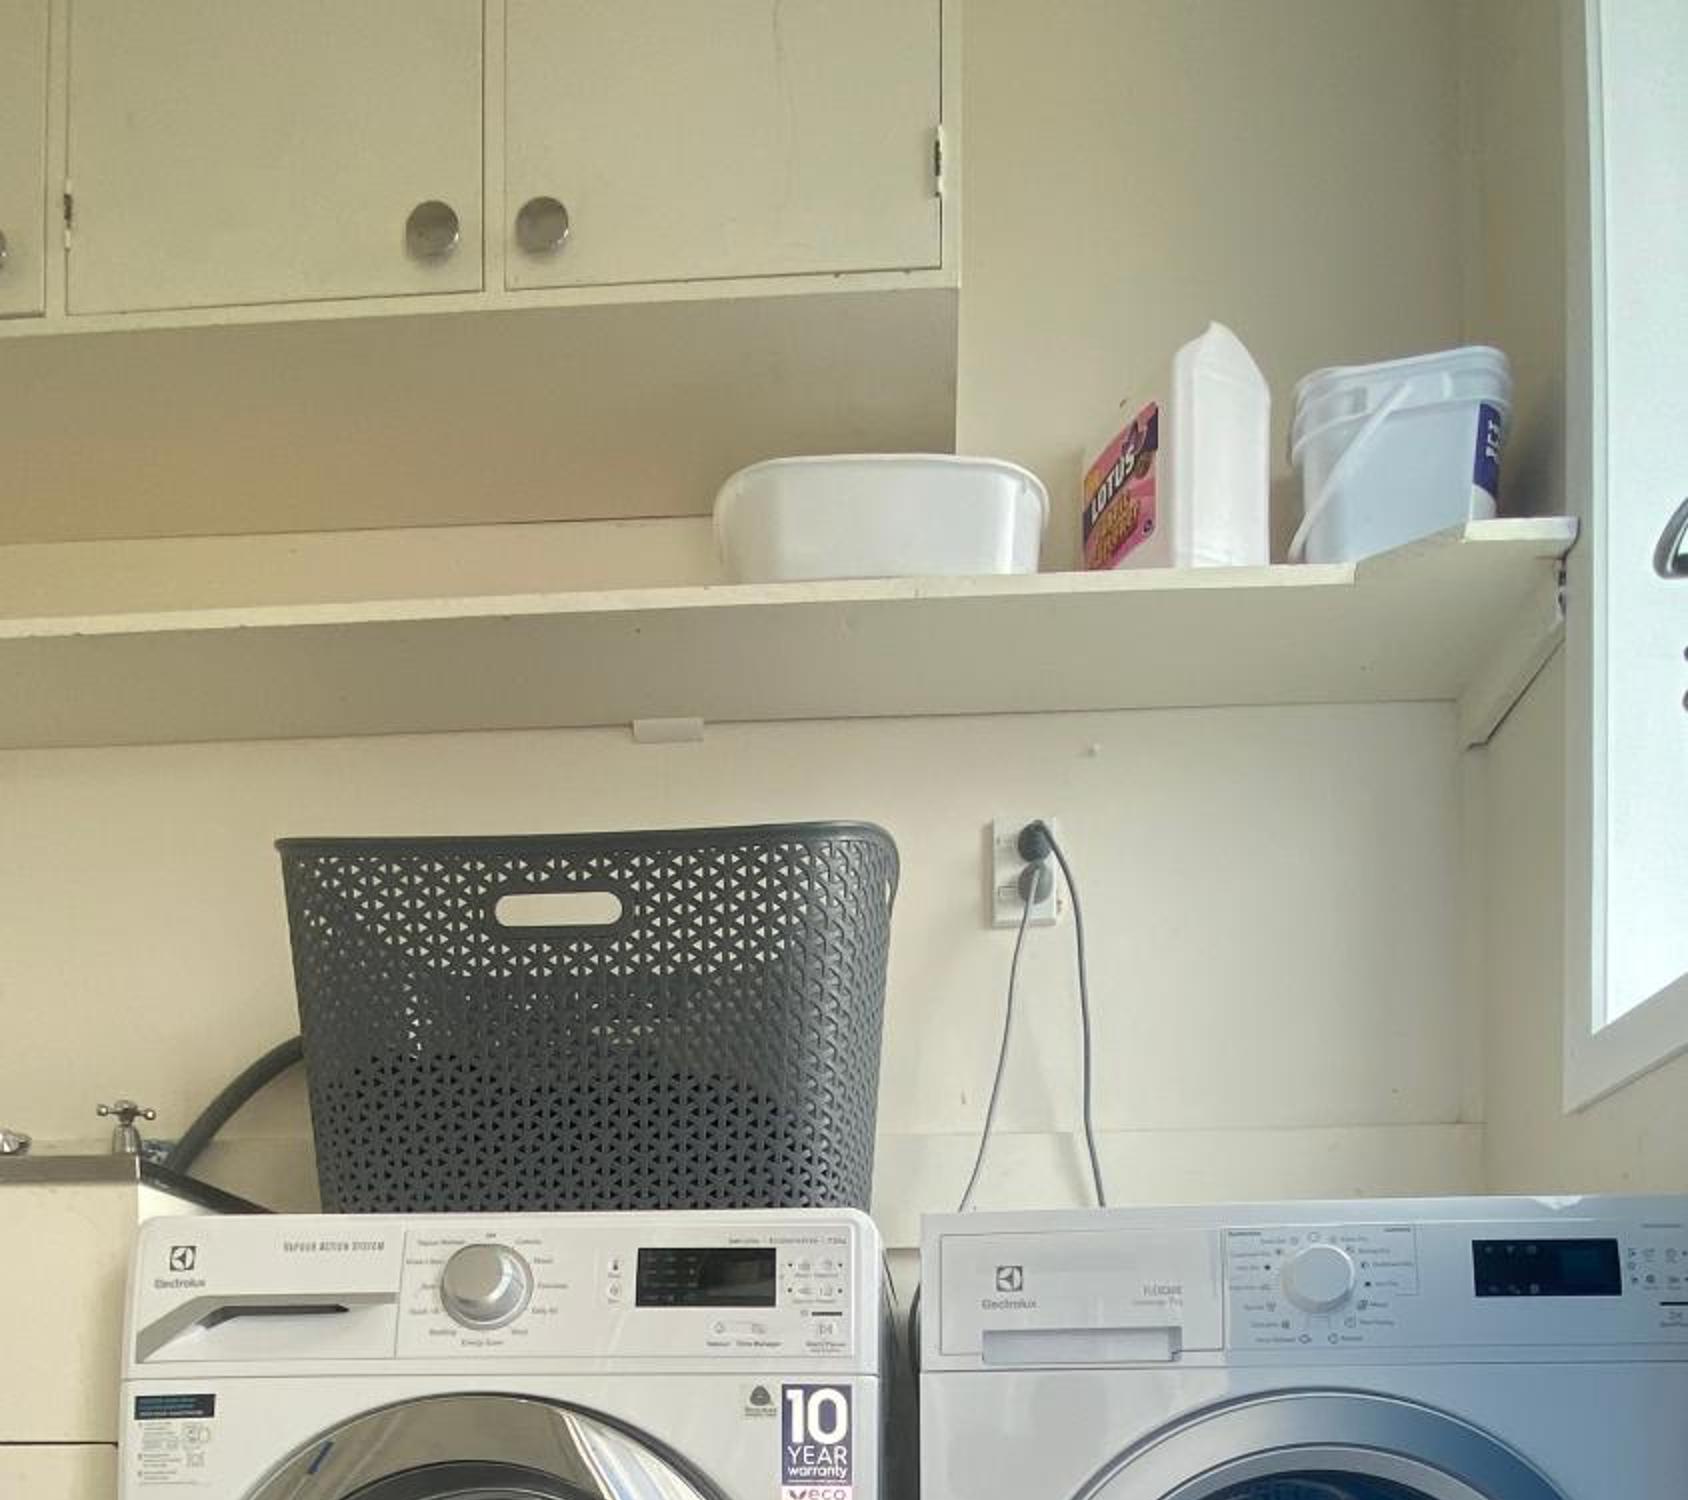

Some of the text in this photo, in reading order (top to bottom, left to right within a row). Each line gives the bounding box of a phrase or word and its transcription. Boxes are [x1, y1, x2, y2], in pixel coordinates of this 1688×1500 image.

[1091, 445, 1136, 524] LOTUS
[154, 1277, 206, 1289] Electrolux
[981, 1298, 1037, 1310] Electrolux
[786, 1387, 848, 1444] 10
[787, 1445, 848, 1465] YEAR
[787, 1465, 848, 1479] warranty
[808, 1489, 846, 1500] eco
